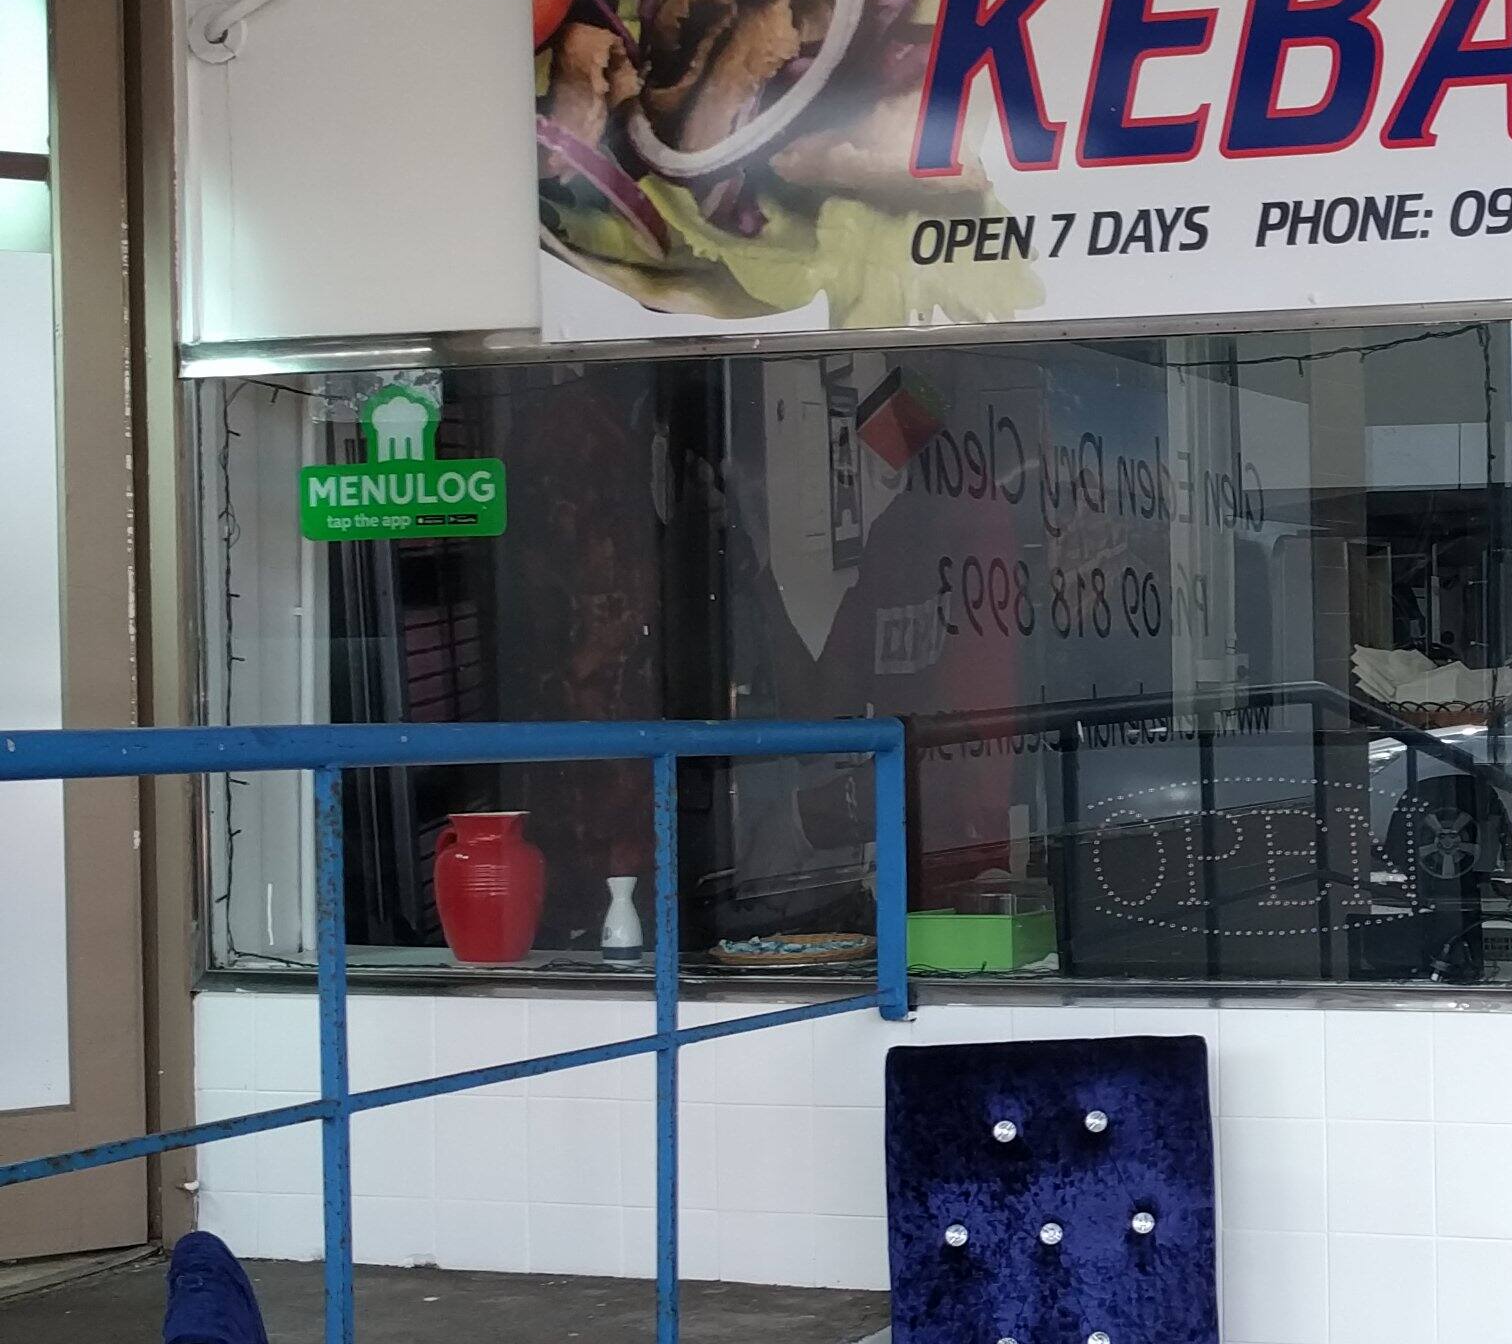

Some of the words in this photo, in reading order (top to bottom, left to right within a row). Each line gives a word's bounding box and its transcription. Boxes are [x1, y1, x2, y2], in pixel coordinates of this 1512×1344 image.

[912, 215, 1035, 265] OPEN
[1049, 212, 1077, 258] 7
[1087, 205, 1210, 256] DAYS
[1255, 192, 1434, 248] PHONE:
[308, 470, 497, 507] MENULOG
[326, 515, 352, 532] tap
[354, 513, 380, 529] the
[382, 514, 413, 531] app
[1093, 807, 1426, 907] OPEN
